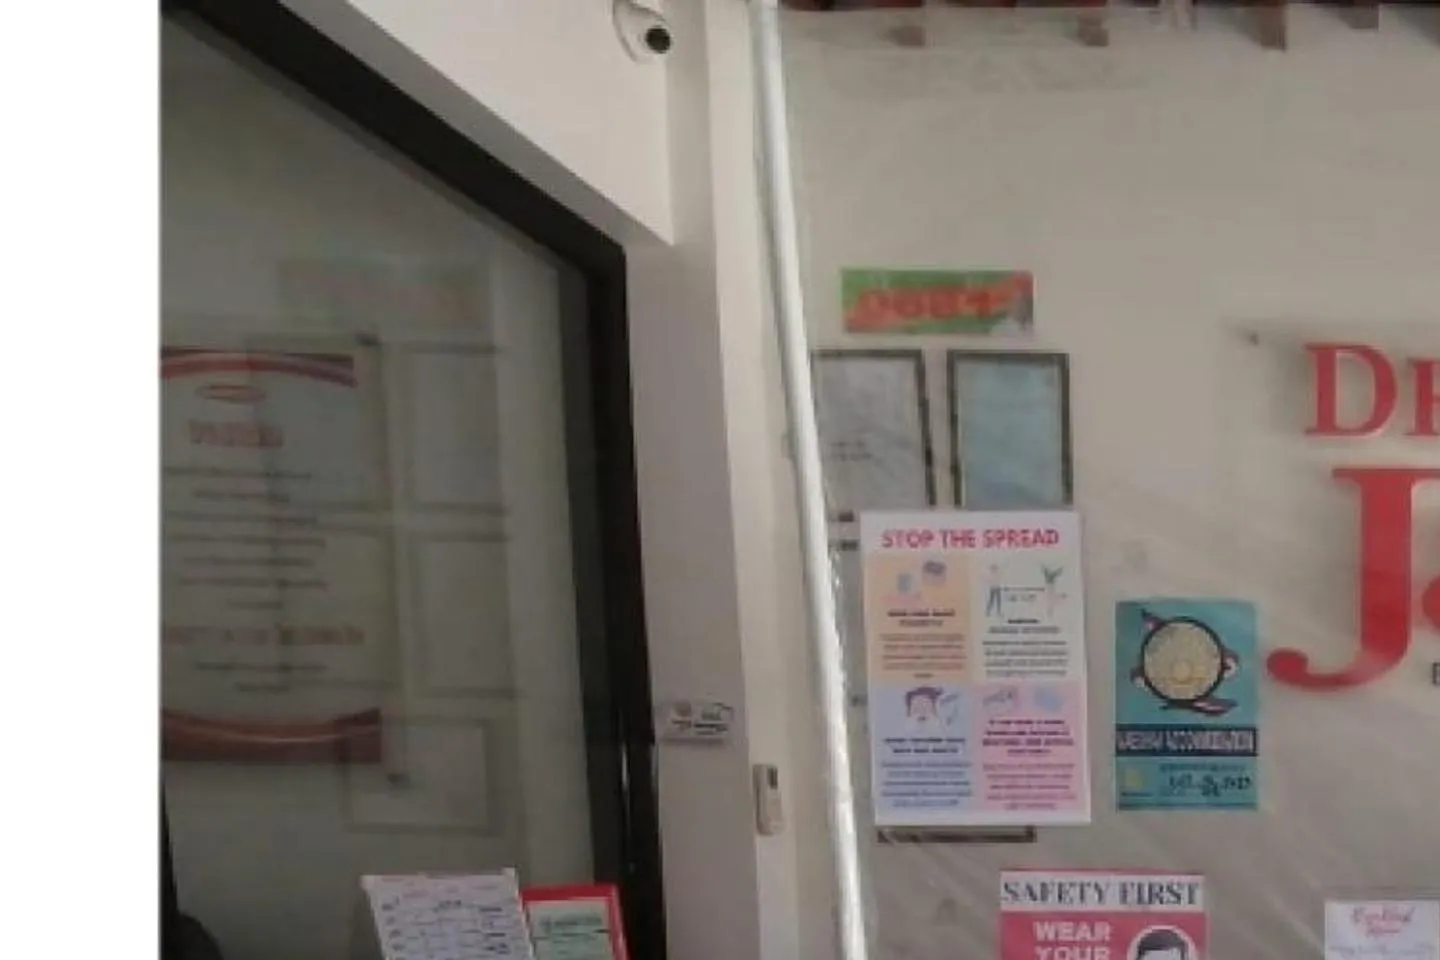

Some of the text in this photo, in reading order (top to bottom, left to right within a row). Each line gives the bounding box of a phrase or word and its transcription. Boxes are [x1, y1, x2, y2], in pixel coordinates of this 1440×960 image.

[880, 527, 1060, 549] STOP THE SPREAD
[1002, 880, 1200, 906] SAFETY FIRST
[1032, 920, 1112, 942] WEAR
